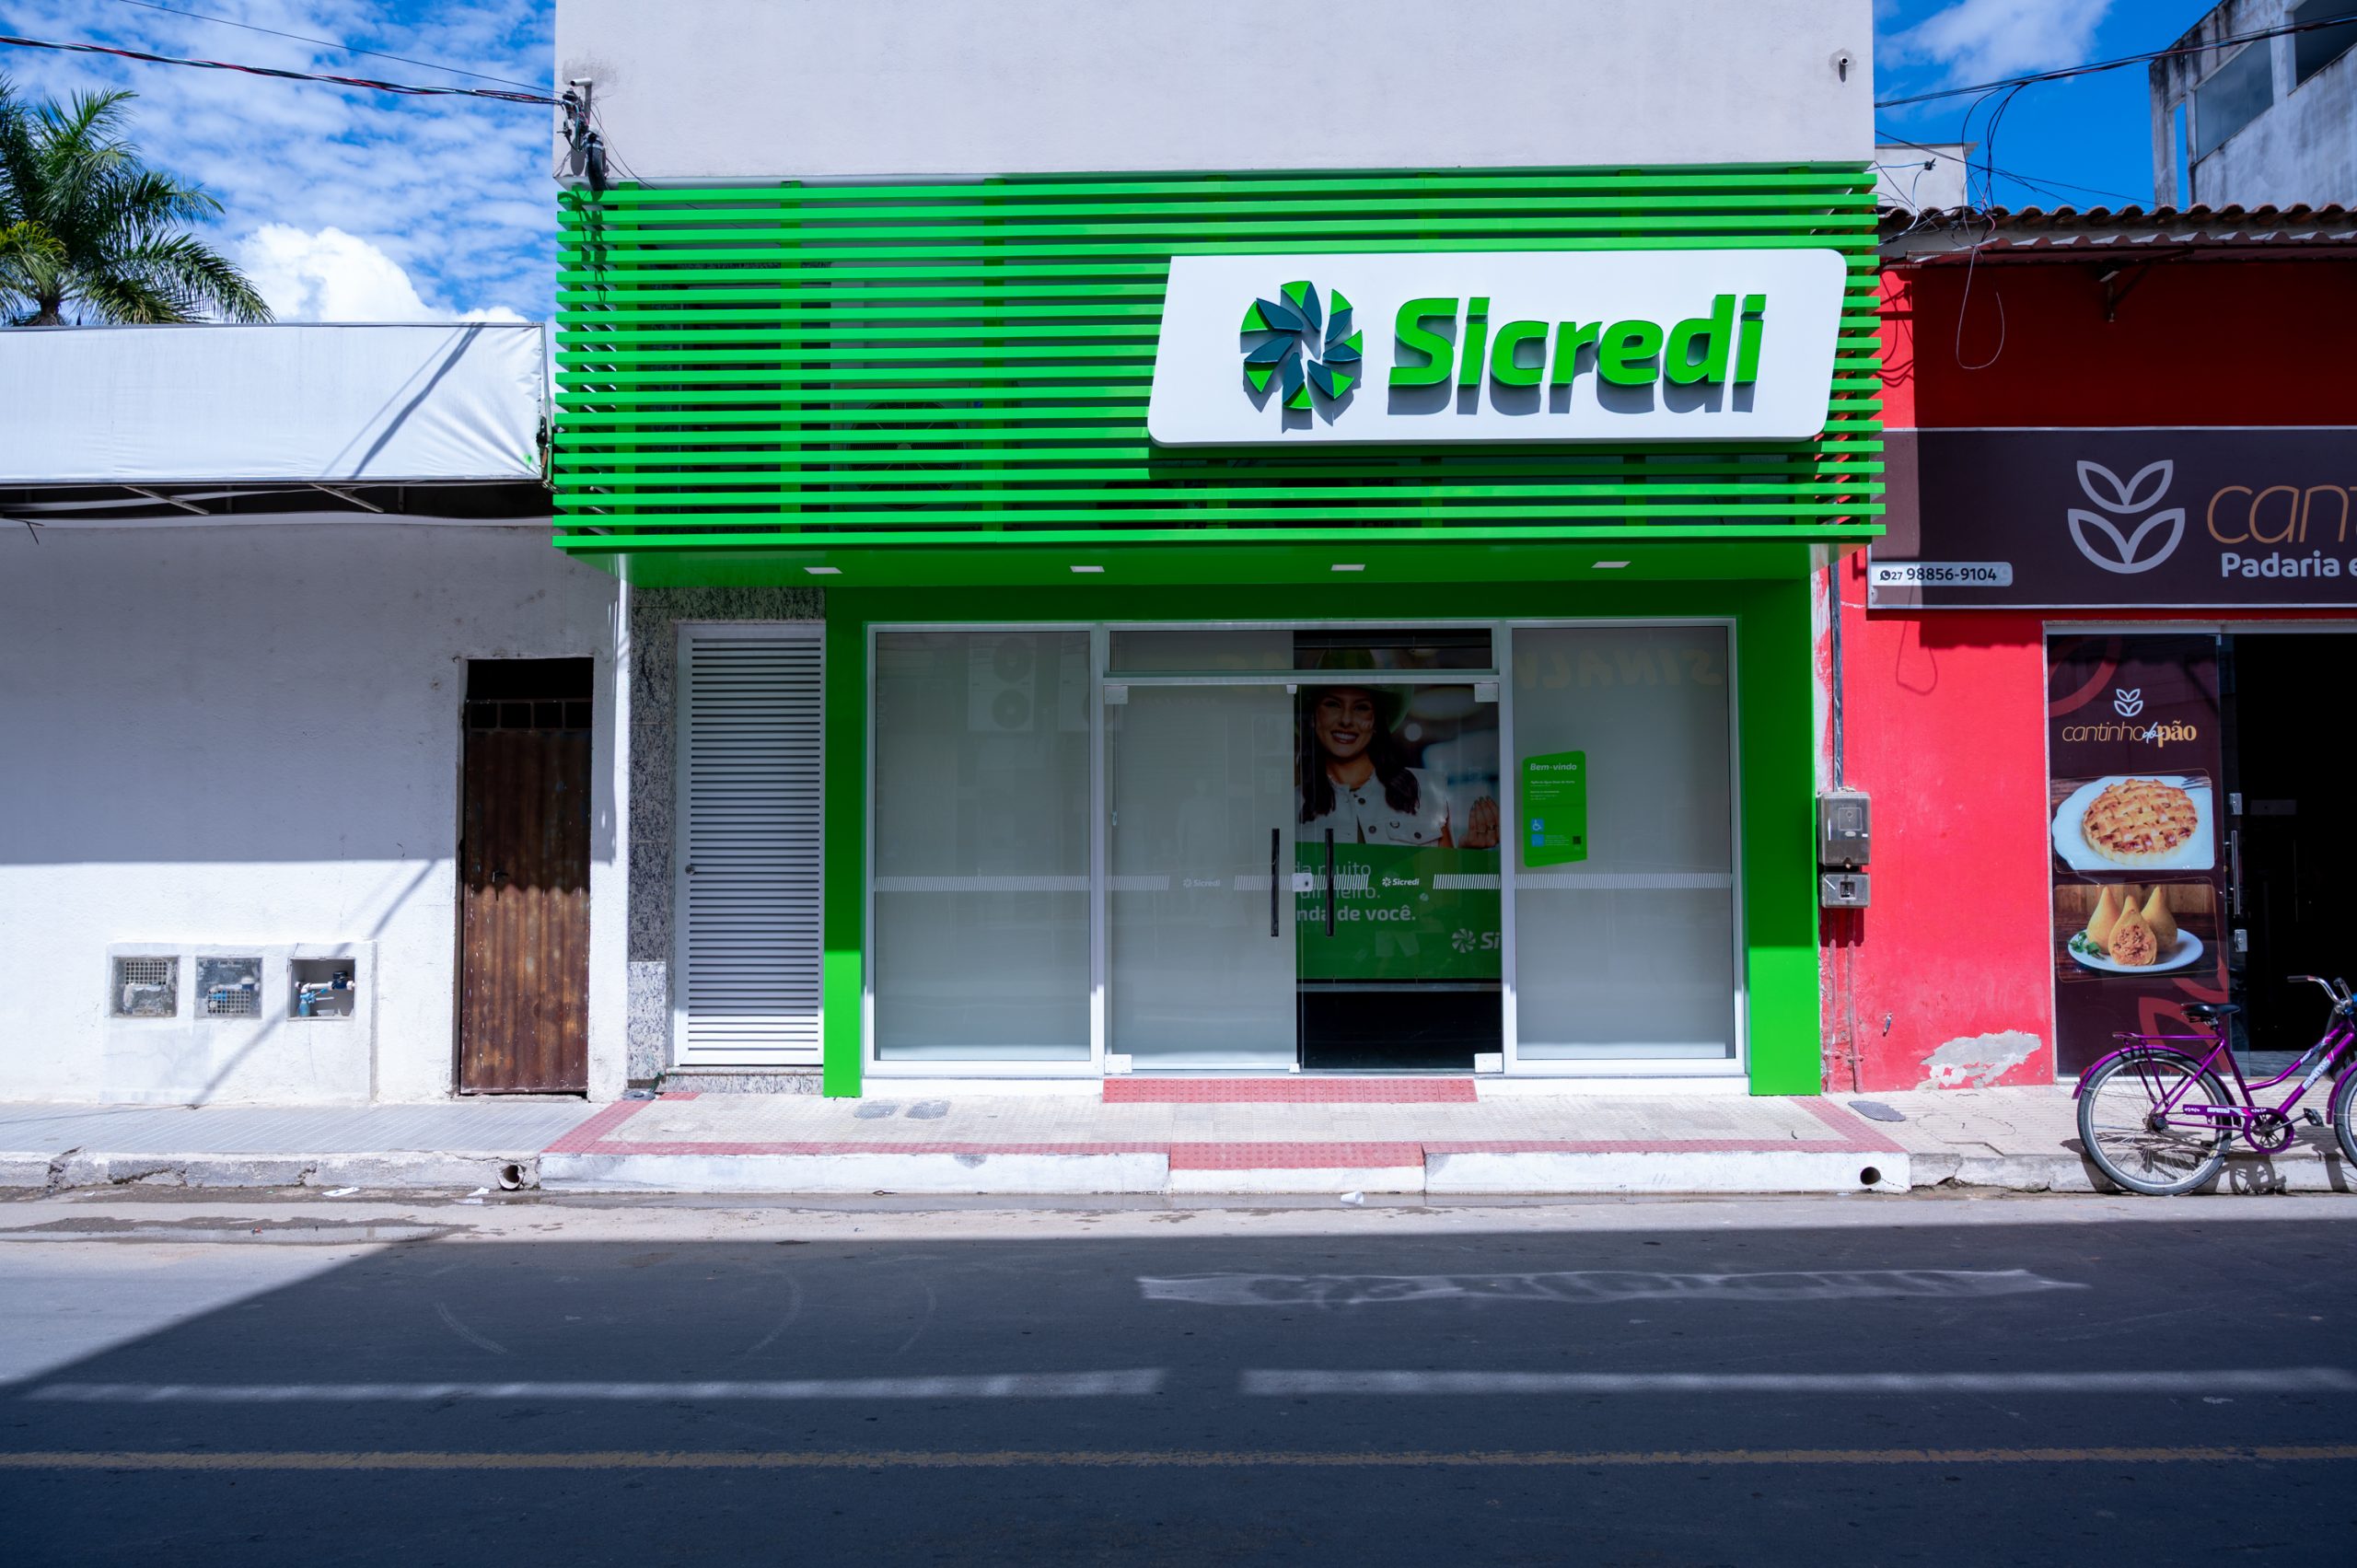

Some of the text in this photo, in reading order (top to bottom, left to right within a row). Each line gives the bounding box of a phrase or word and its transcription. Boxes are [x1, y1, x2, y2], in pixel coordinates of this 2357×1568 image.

[1387, 293, 1768, 389] Sicredi
[2207, 484, 2357, 543] can
[1891, 567, 1997, 581] 27 98856-9104
[2221, 550, 2340, 578] Padaria
[2062, 722, 2145, 741] cantinho
[2157, 719, 2197, 748] pão
[1392, 877, 1420, 887] Sicredi
[1337, 905, 1360, 921] de
[1364, 905, 1416, 921] você.
